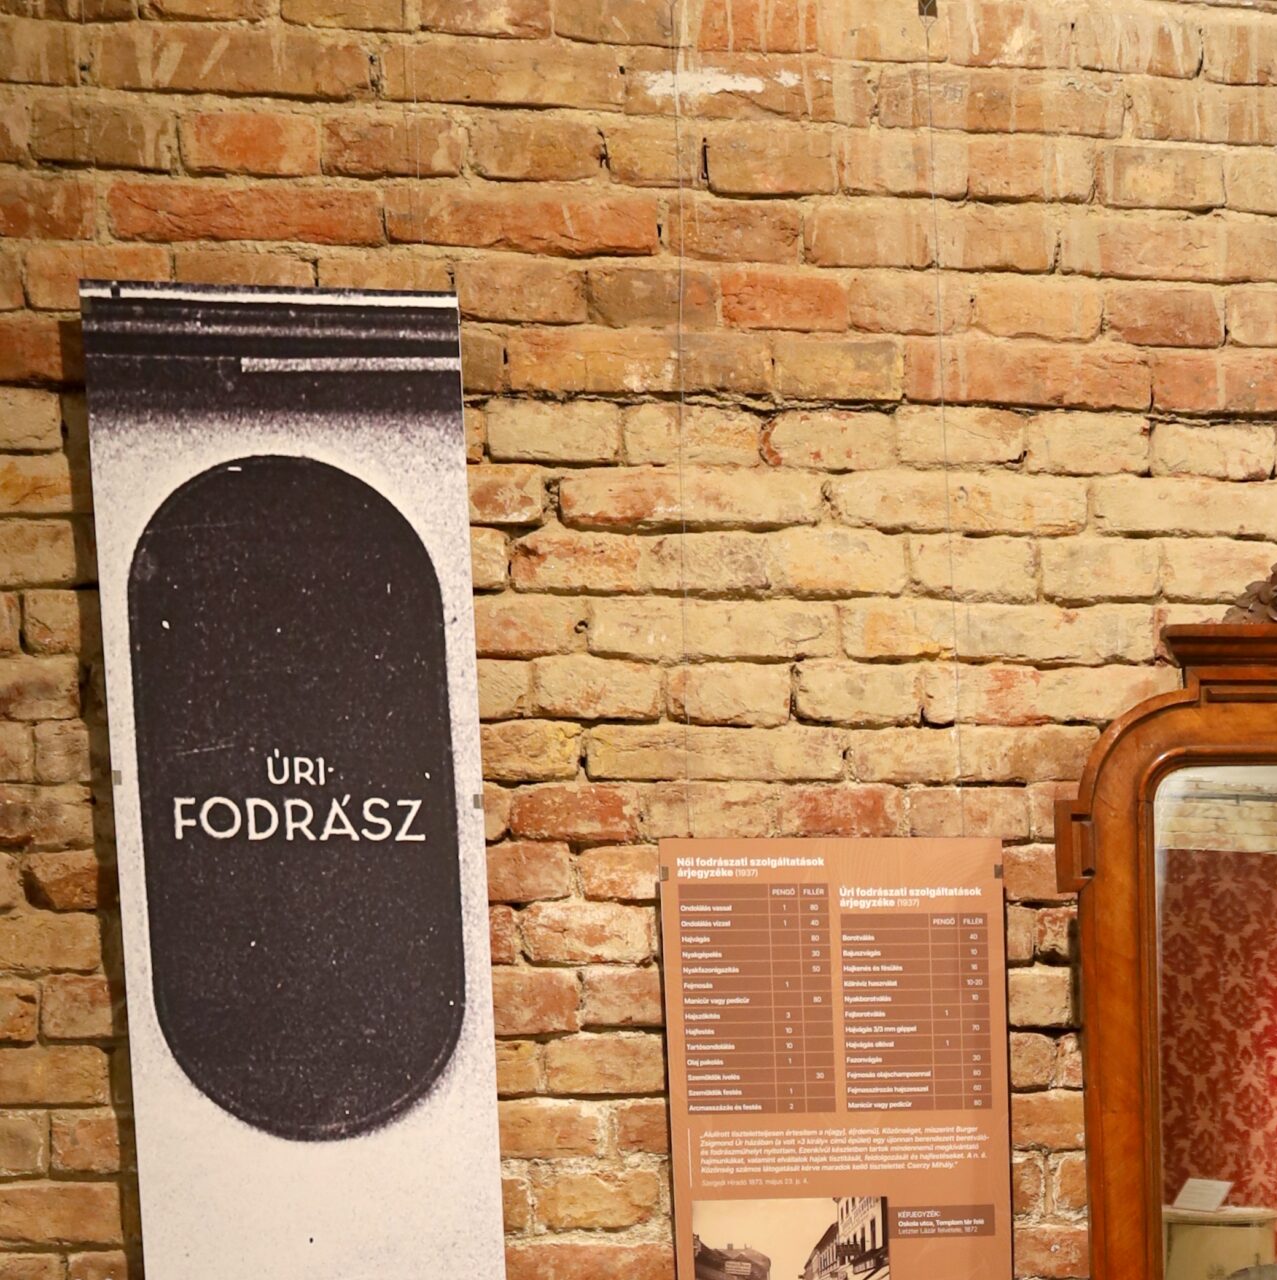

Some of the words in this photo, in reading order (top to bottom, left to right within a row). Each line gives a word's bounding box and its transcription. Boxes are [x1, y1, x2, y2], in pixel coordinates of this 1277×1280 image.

[173, 794, 426, 841] FODRÁSZ
[677, 858, 694, 866] Női
[696, 857, 748, 866] fodrászati
[750, 857, 824, 869] szolgáltatások
[677, 868, 733, 878] árjegyzéke
[735, 869, 758, 878] (1937)
[839, 886, 854, 897] Úri
[856, 886, 907, 897] fodrászati
[909, 886, 982, 898] szolgáltatások
[840, 898, 895, 908] árjegyzéke
[897, 899, 919, 908] (1937)
